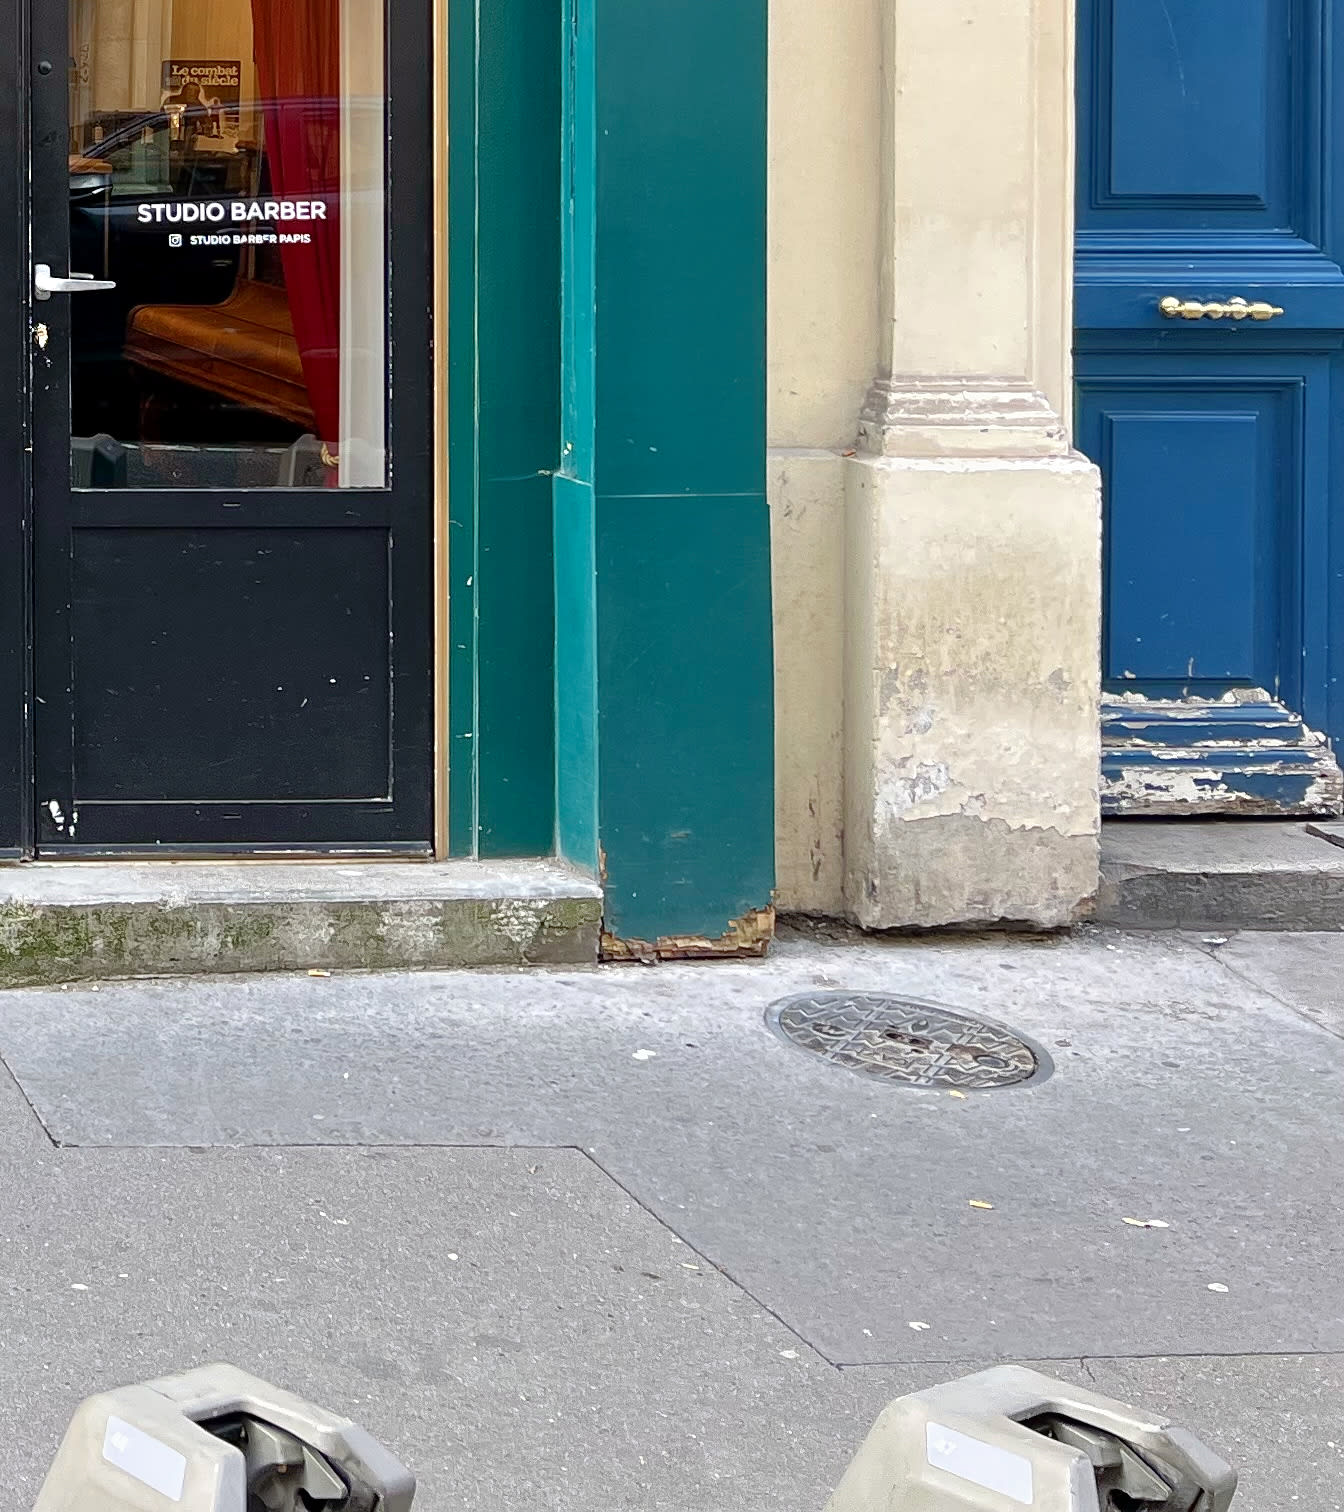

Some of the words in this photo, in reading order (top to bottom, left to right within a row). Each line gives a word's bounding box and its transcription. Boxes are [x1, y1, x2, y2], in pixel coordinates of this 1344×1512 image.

[172, 64, 189, 75] Le
[190, 65, 239, 76] combat
[137, 202, 226, 223] STUDIO
[230, 200, 327, 222] BARBER
[190, 234, 231, 245] STUDIO
[233, 234, 277, 244] BARBER
